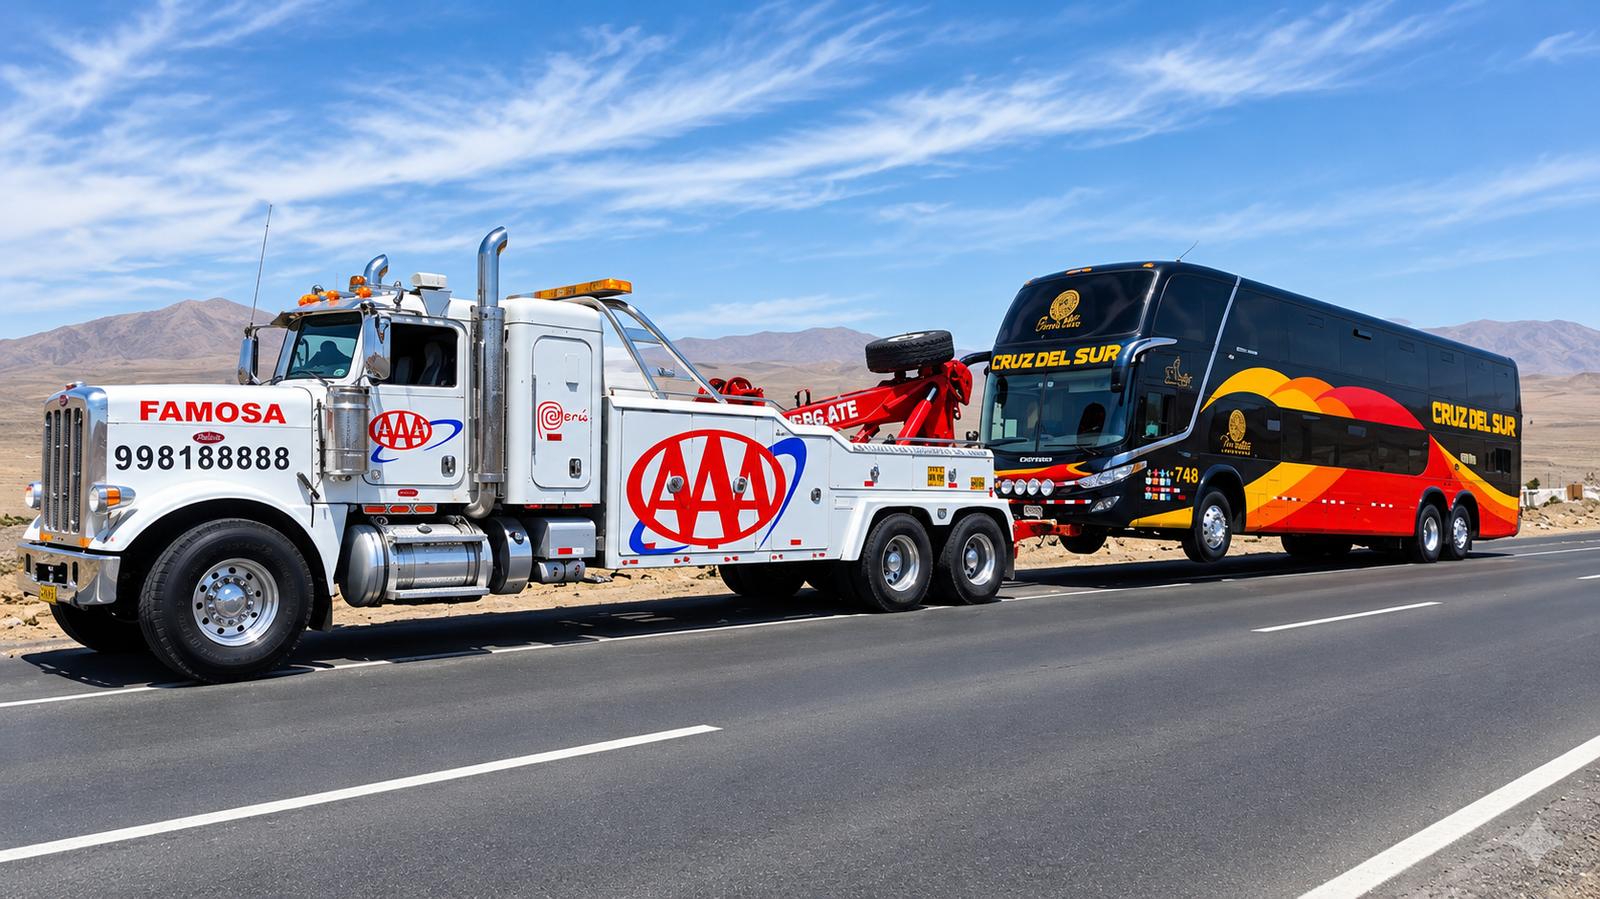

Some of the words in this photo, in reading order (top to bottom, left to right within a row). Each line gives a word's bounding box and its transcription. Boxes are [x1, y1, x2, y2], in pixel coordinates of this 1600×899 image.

[991, 353, 1036, 370] CRUZ
[1034, 350, 1071, 368] DEL
[1073, 344, 1122, 365] SUR
[139, 400, 287, 424] FAMOSA
[1432, 401, 1468, 429] CRUZ
[1468, 408, 1491, 433] DEL
[1491, 413, 1516, 438] SUR
[371, 410, 431, 450] AAA
[114, 445, 290, 470] 998188888
[637, 431, 780, 542] AAA
[1175, 466, 1199, 484] 748
